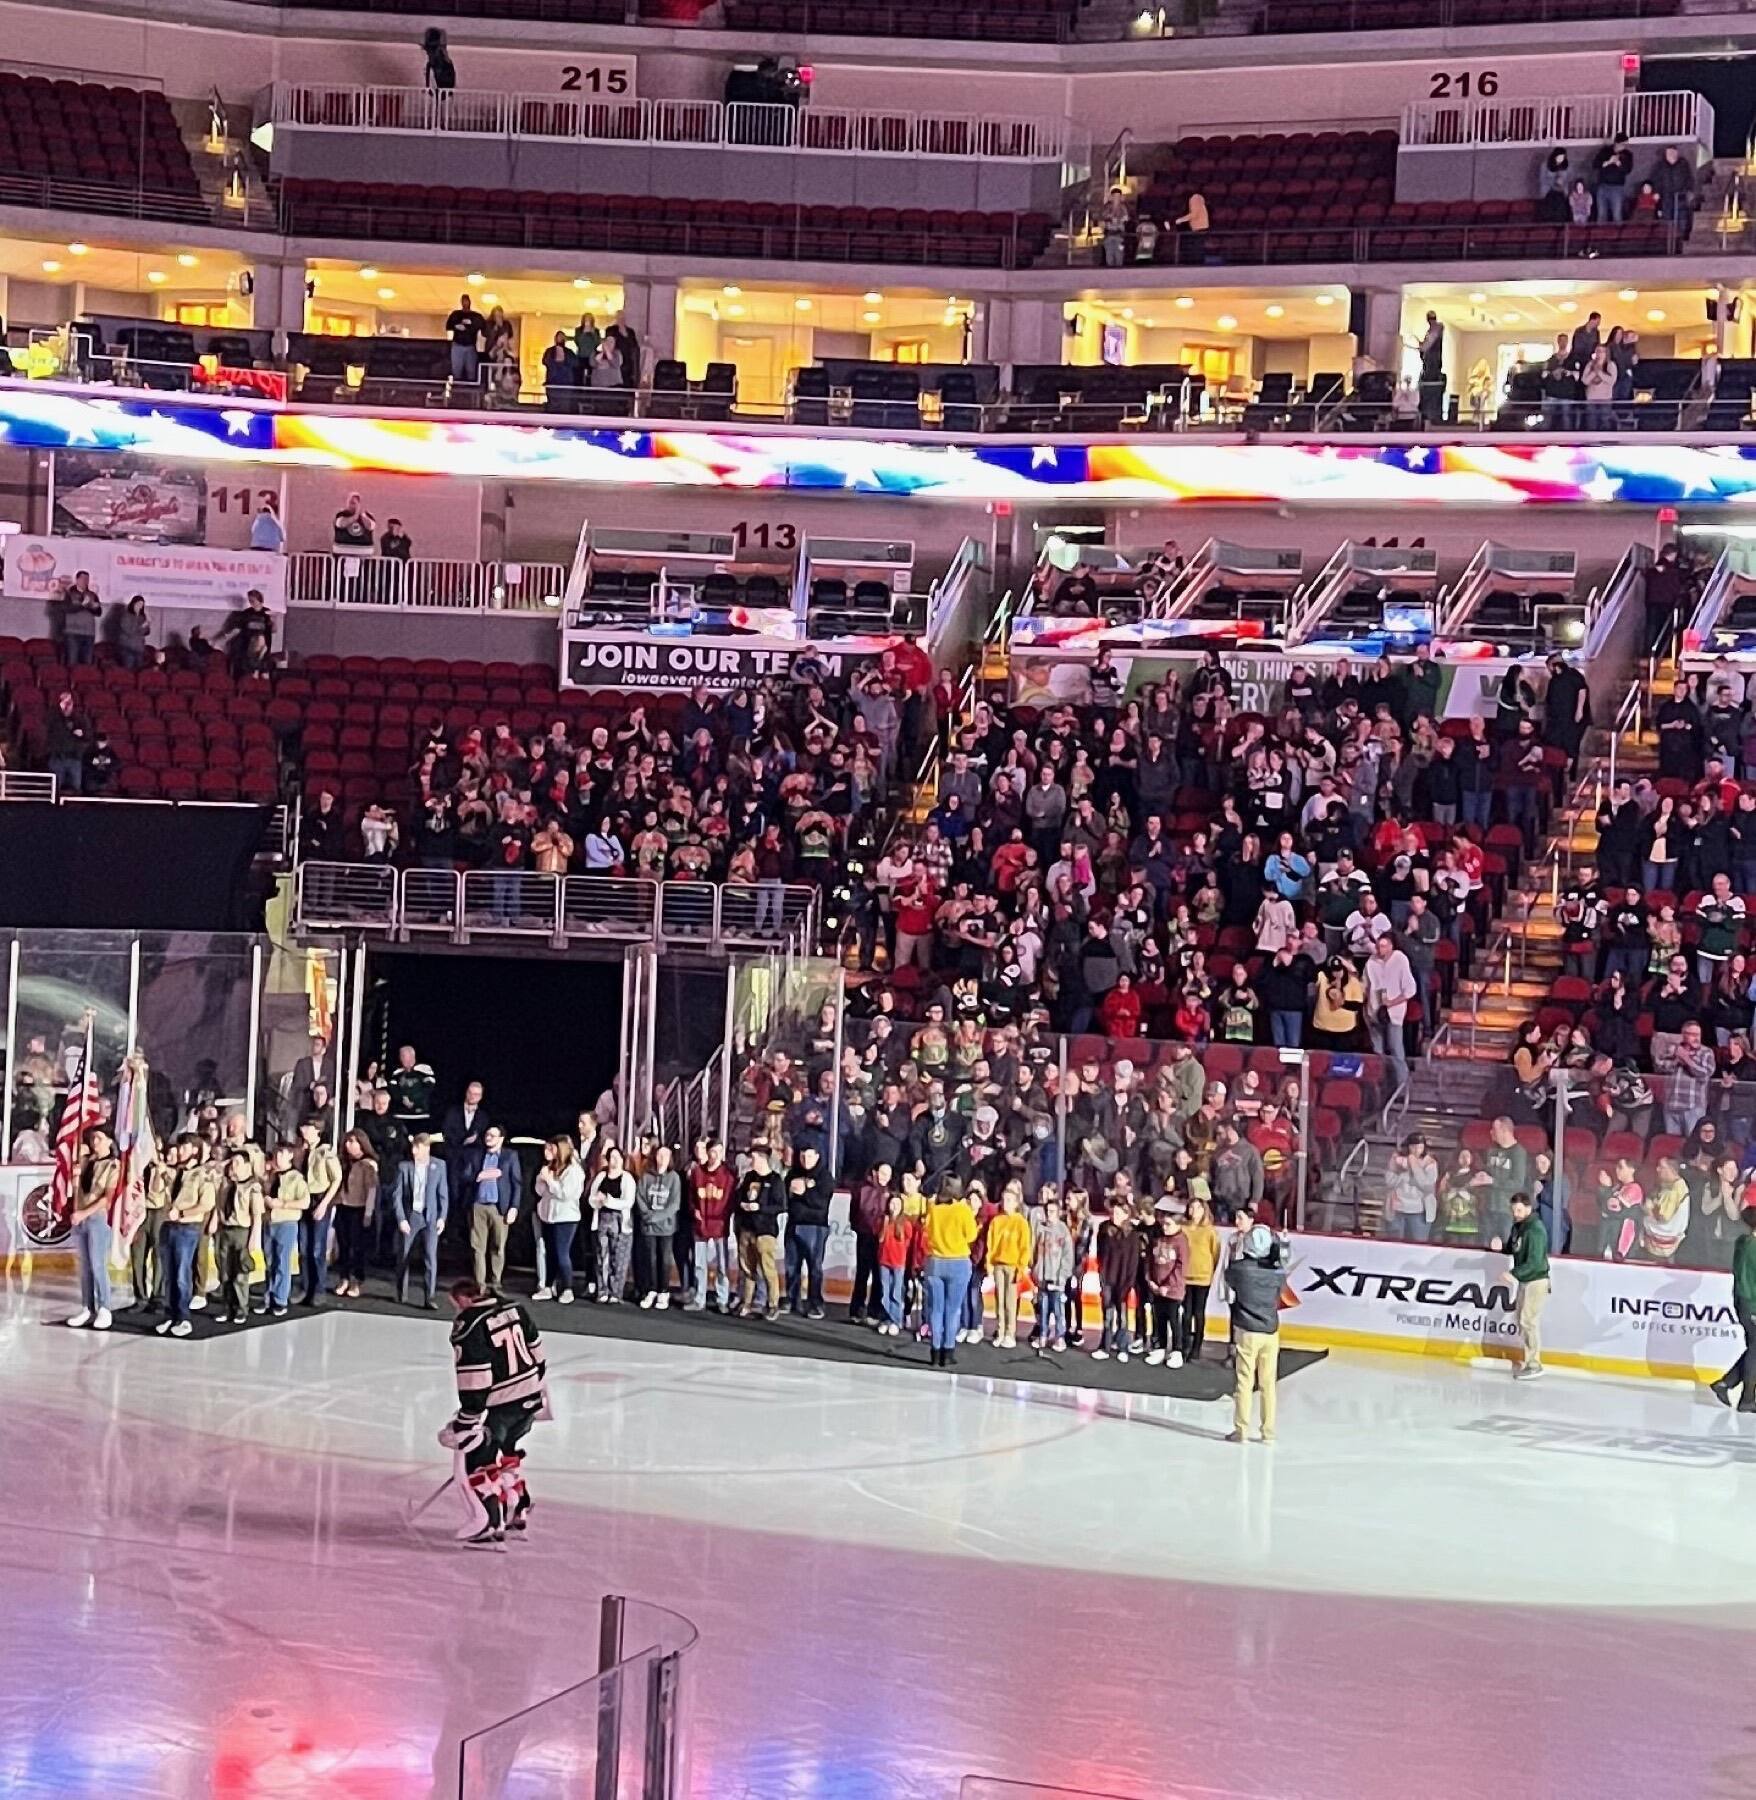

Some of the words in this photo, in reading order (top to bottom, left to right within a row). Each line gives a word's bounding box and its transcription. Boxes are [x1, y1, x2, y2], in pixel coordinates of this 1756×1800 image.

[561, 66, 628, 94] 215
[1429, 71, 1498, 99] 216
[731, 521, 797, 550] 113
[580, 644, 657, 669] JOIN
[668, 648, 740, 674] OUR
[750, 651, 842, 677] TEM
[1255, 659, 1317, 681] THINS
[1445, 1312, 1518, 1336] Mediaco
[1611, 1296, 1738, 1325] INFOMA
[1632, 1320, 1674, 1334] OFFICE
[1680, 1324, 1738, 1339] SYSTEMS
[490, 1323, 534, 1376] 70
